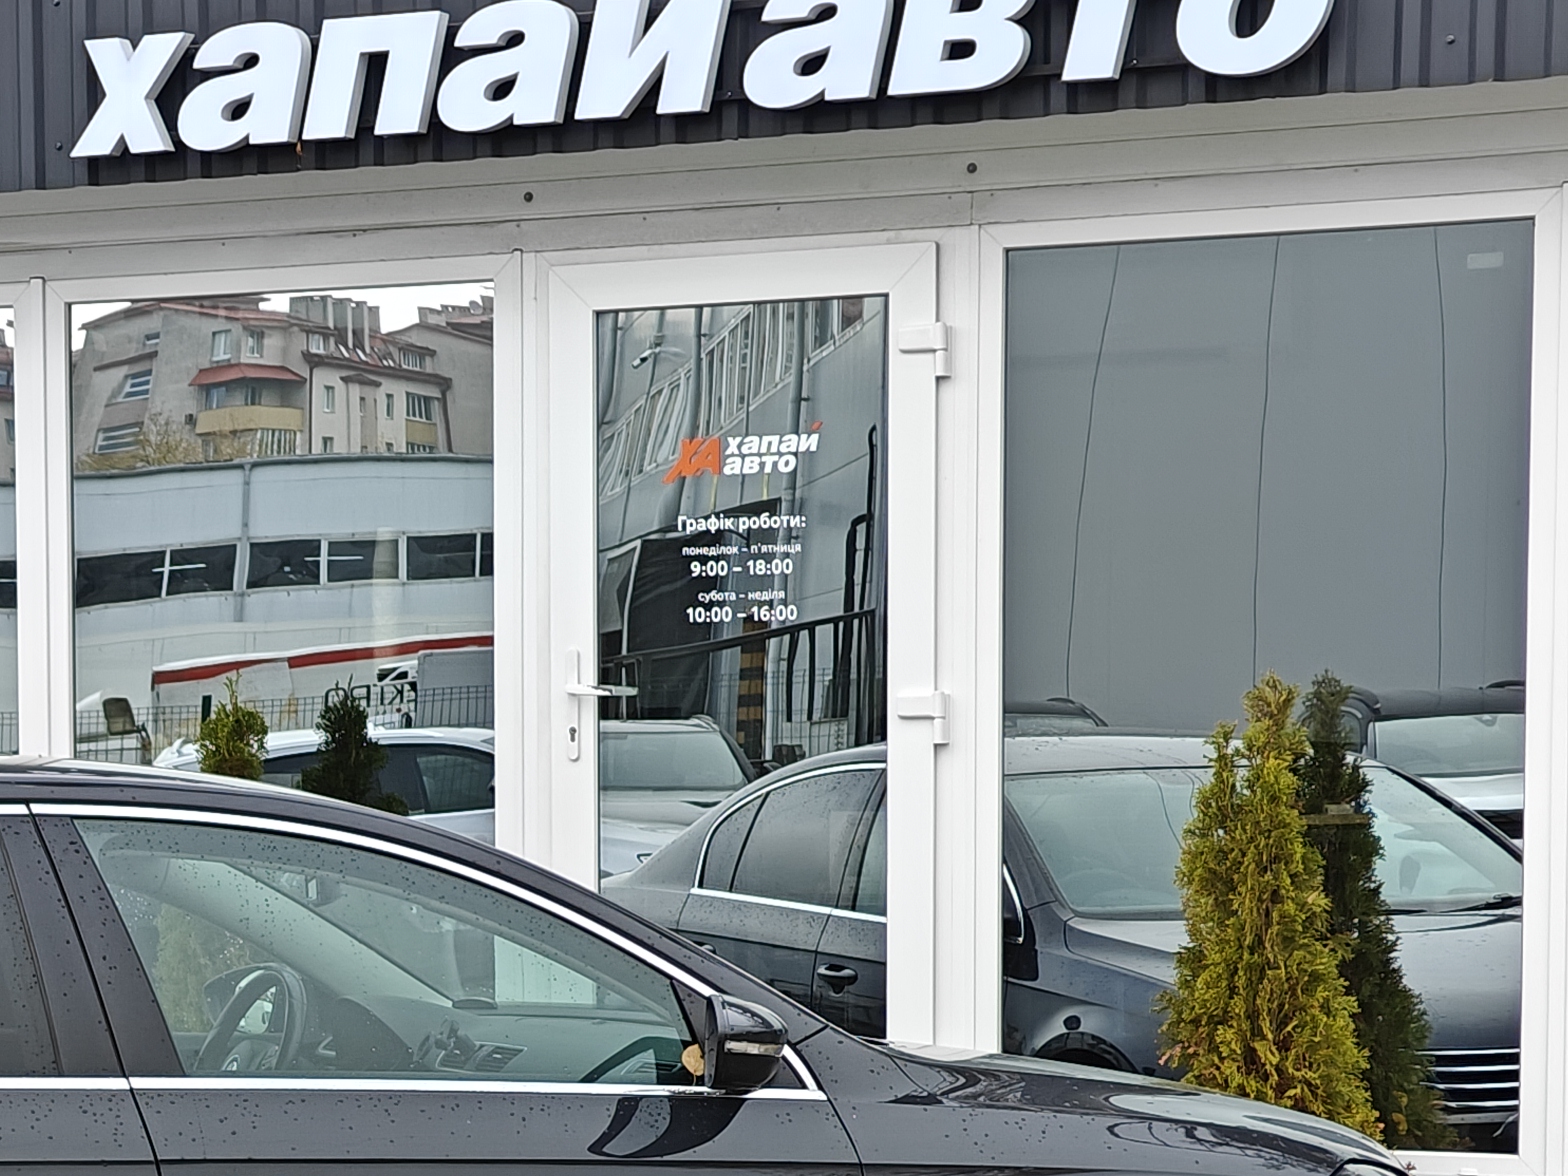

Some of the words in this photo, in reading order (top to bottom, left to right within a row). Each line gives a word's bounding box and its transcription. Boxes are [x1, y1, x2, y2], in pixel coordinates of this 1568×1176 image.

[724, 421, 823, 455] хапай
[723, 453, 797, 476] авто
[677, 515, 734, 534] Графік
[738, 512, 807, 531] роботи:
[682, 545, 739, 557] понеділок
[690, 561, 729, 578] 9:00
[746, 558, 794, 576] 18:00
[697, 591, 736, 603] субота
[747, 588, 785, 601] неділя
[685, 606, 733, 623] 10:00
[750, 604, 798, 622] 16:00
